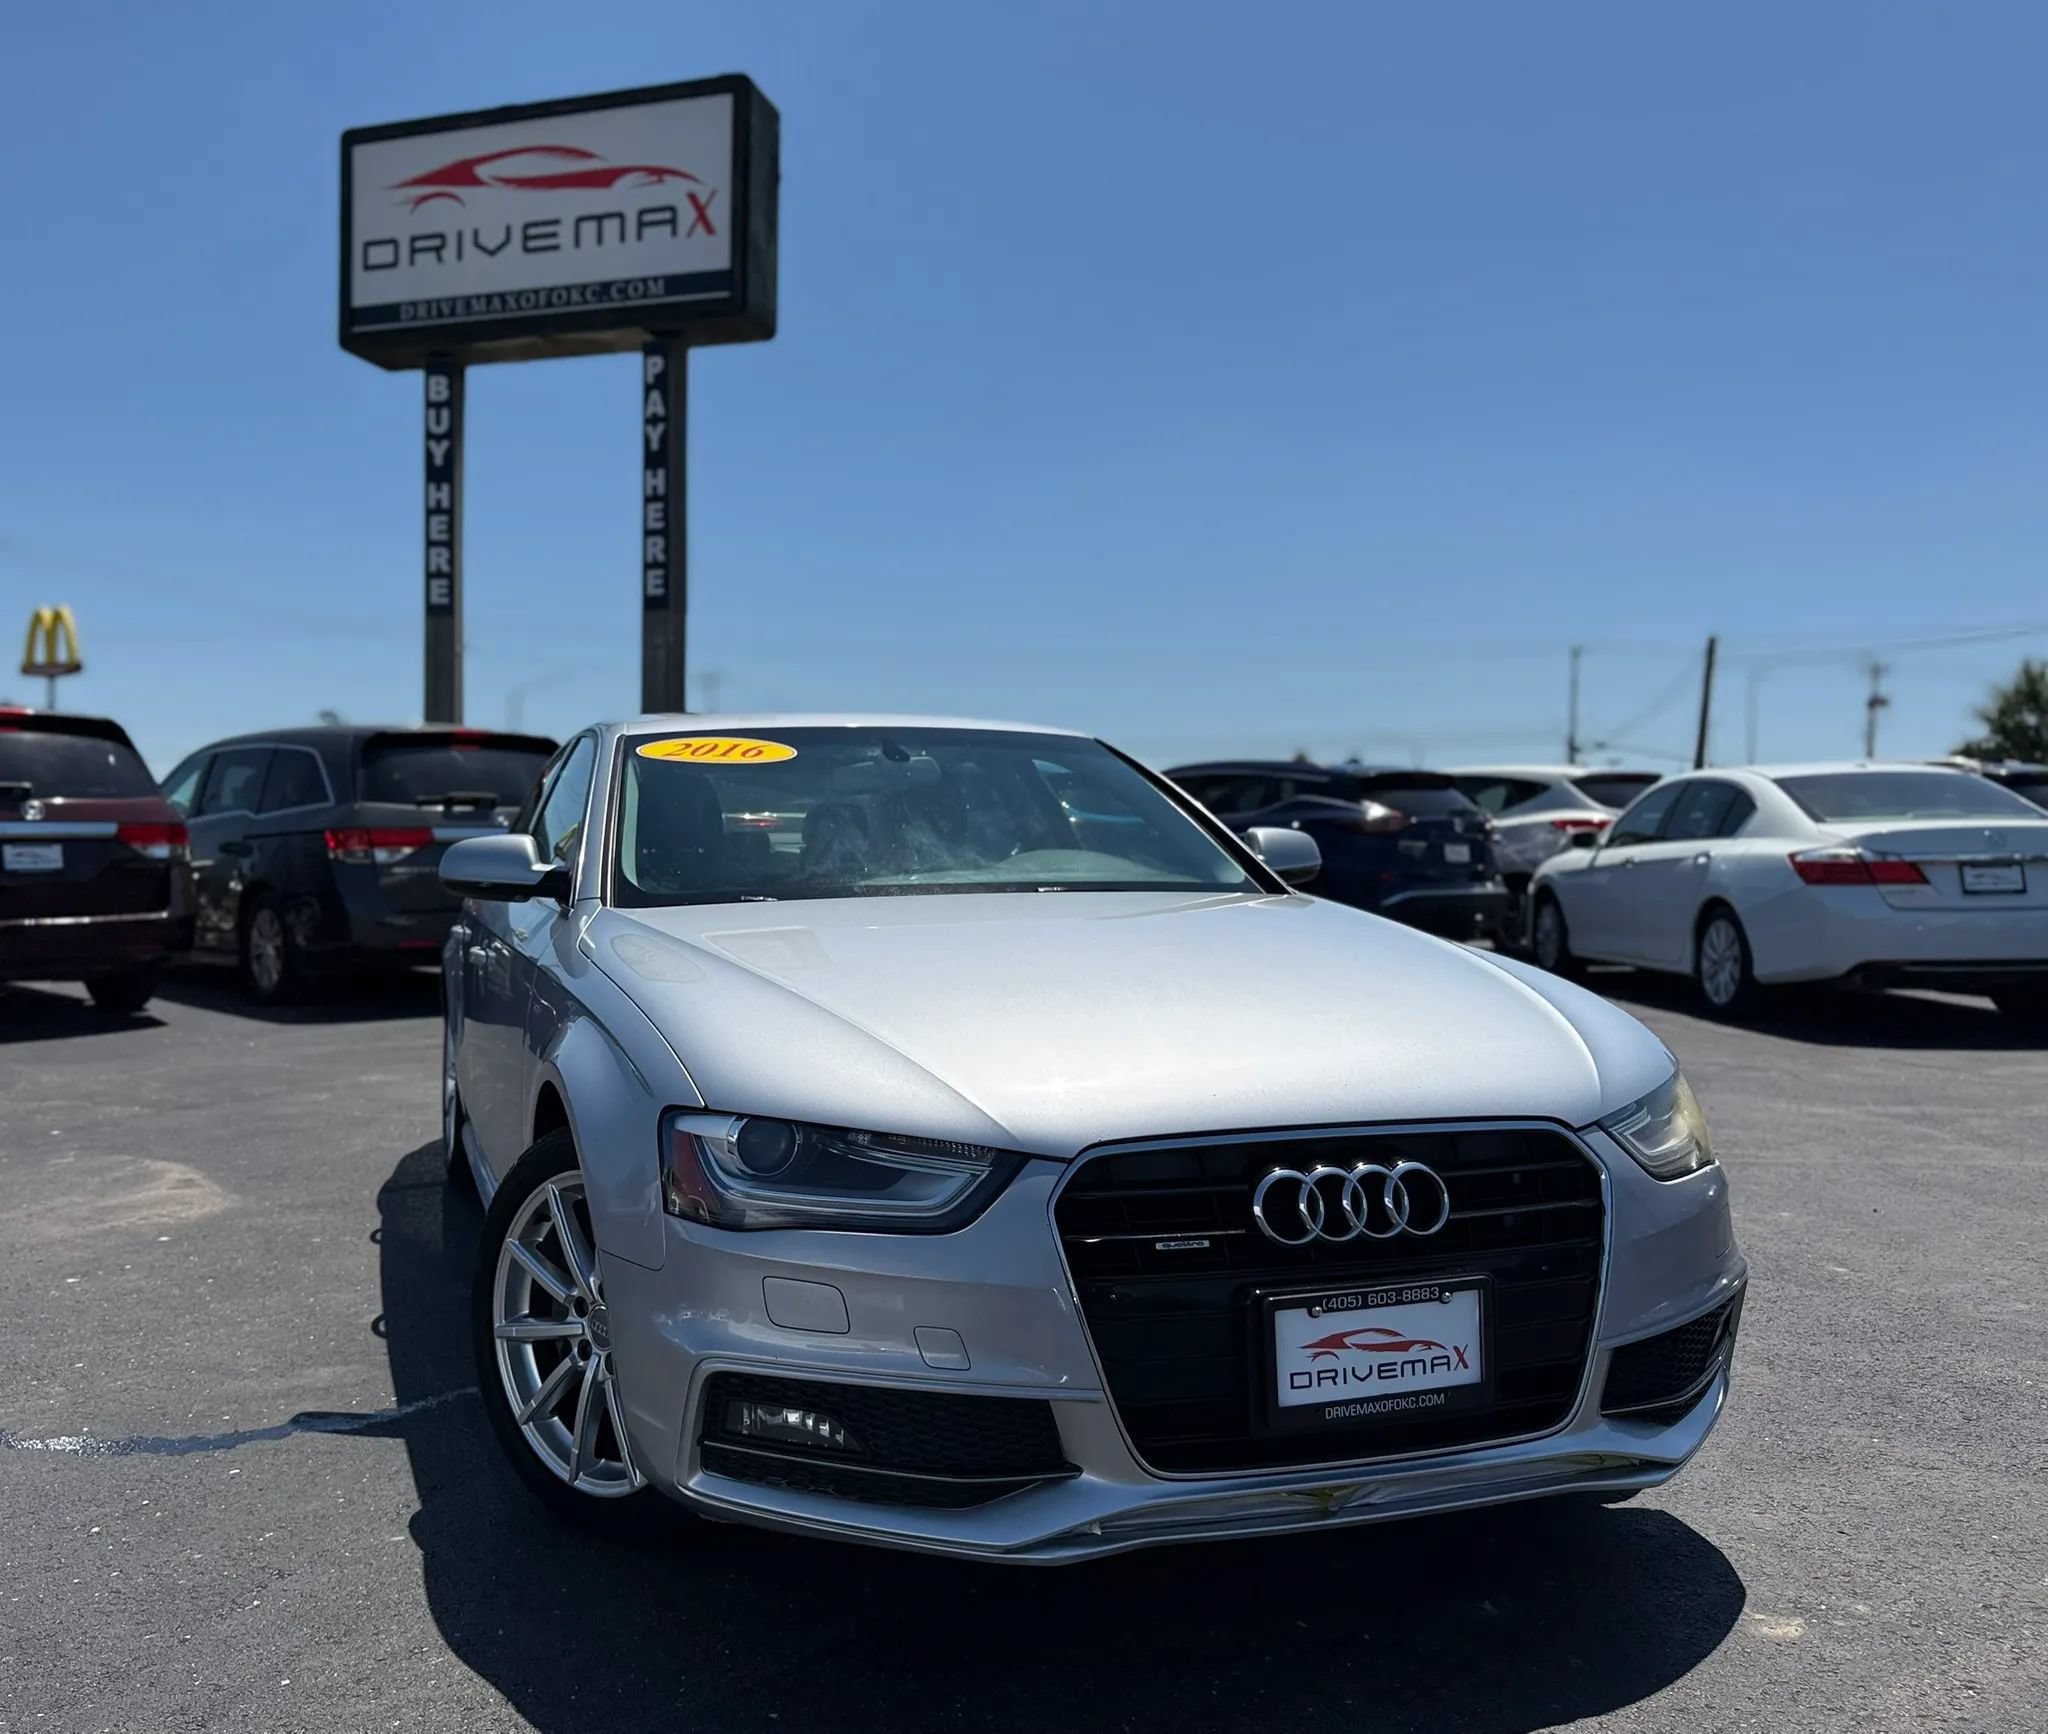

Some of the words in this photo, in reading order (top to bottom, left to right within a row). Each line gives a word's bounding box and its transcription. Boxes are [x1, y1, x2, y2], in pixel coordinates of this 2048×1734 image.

[363, 188, 717, 272] DRIVEMAX
[400, 278, 666, 321] DRIVEMAXOFOKC.COM
[427, 375, 450, 467] BUY
[645, 355, 666, 451] PAY
[428, 482, 450, 604] HERE
[645, 468, 666, 597] HERE
[662, 742, 772, 759] 2016
[1322, 1295, 1362, 1311] (405)
[1367, 1286, 1439, 1306] 603-8883
[1289, 1344, 1470, 1390] DRIVEMAX
[1325, 1393, 1445, 1420] DRIVEMAXOFOKC.COM
